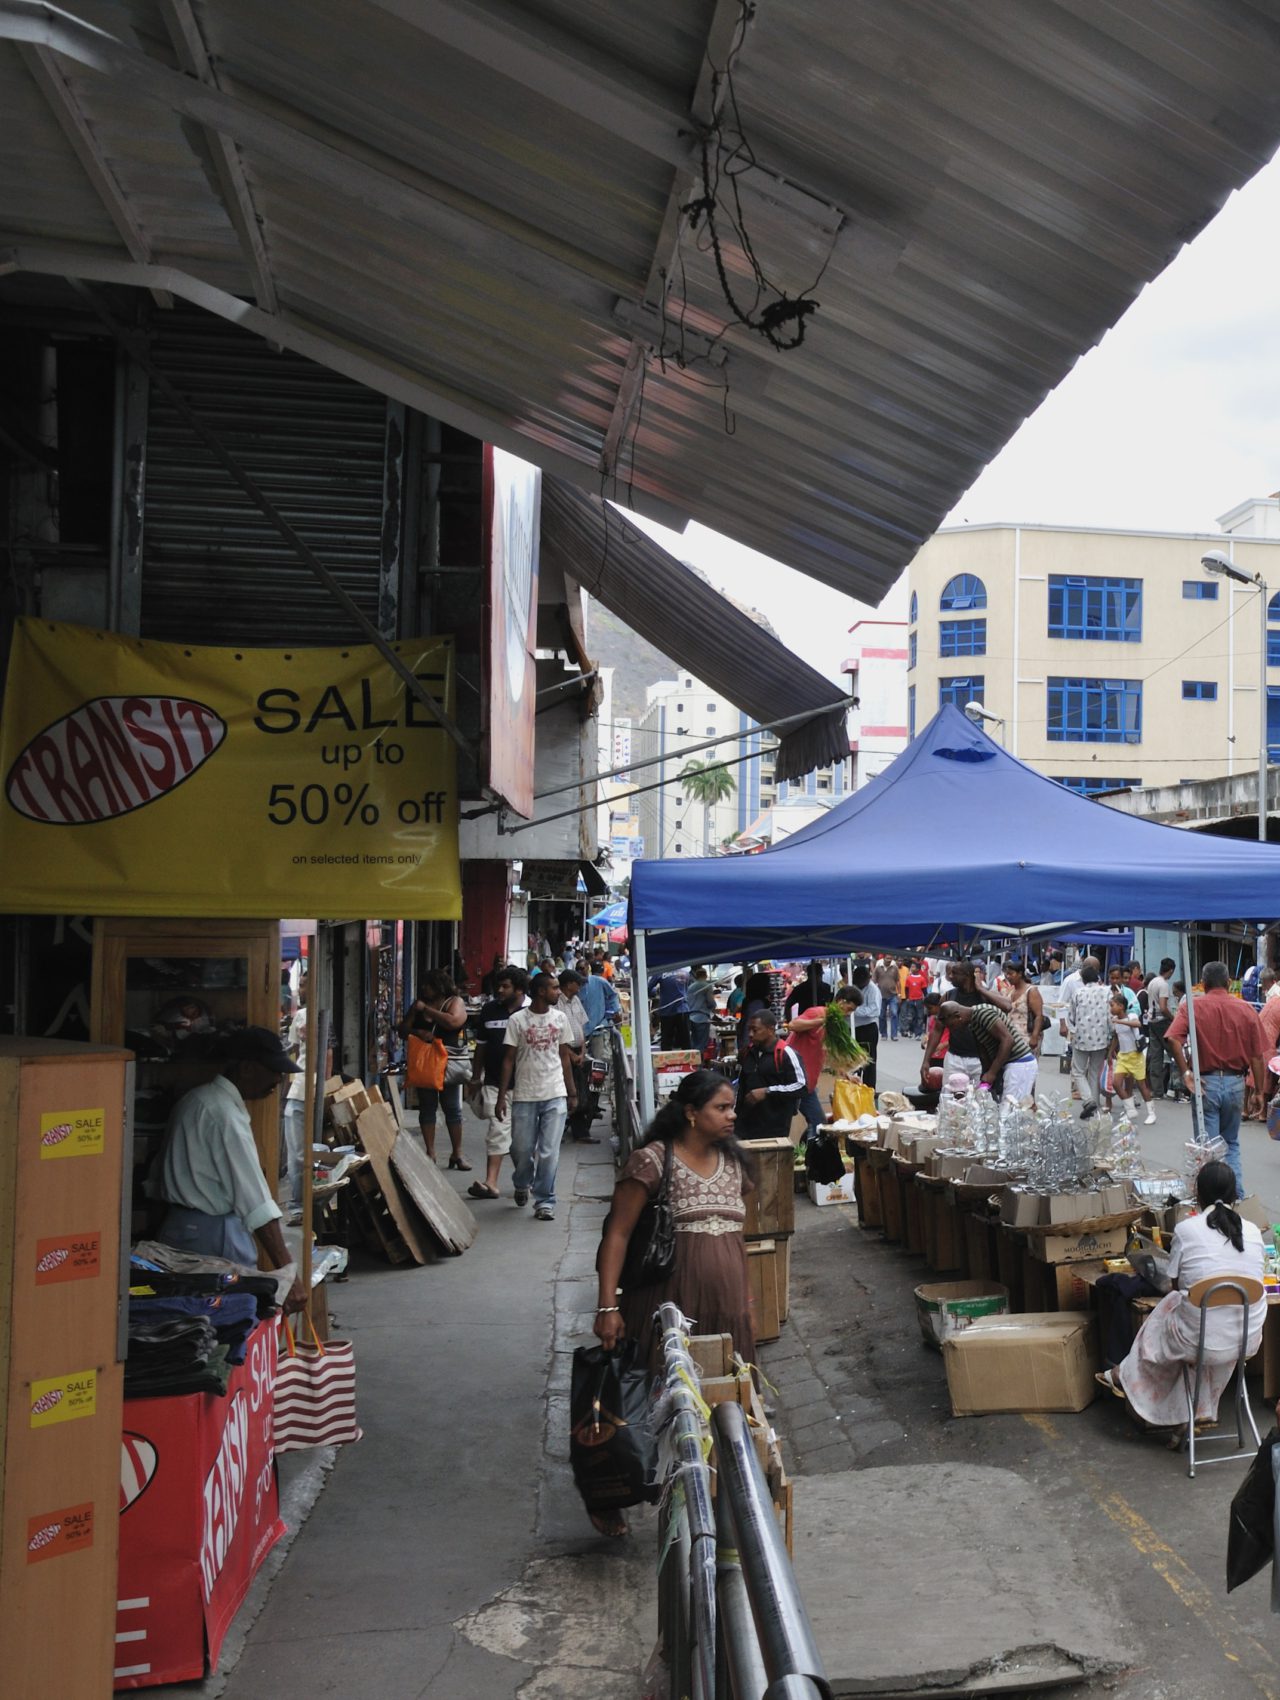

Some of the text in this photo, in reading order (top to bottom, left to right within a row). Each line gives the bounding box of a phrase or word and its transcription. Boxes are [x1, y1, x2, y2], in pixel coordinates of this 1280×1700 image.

[254, 673, 445, 734] SALE
[10, 700, 215, 821] TRANSIT
[322, 738, 404, 770] up to
[268, 783, 446, 826] 50% off
[292, 853, 422, 867] on selected items only
[75, 1118, 102, 1128] SALE
[72, 1241, 98, 1253] SALE
[67, 1380, 94, 1393] SALE
[64, 1512, 92, 1526] SALE
